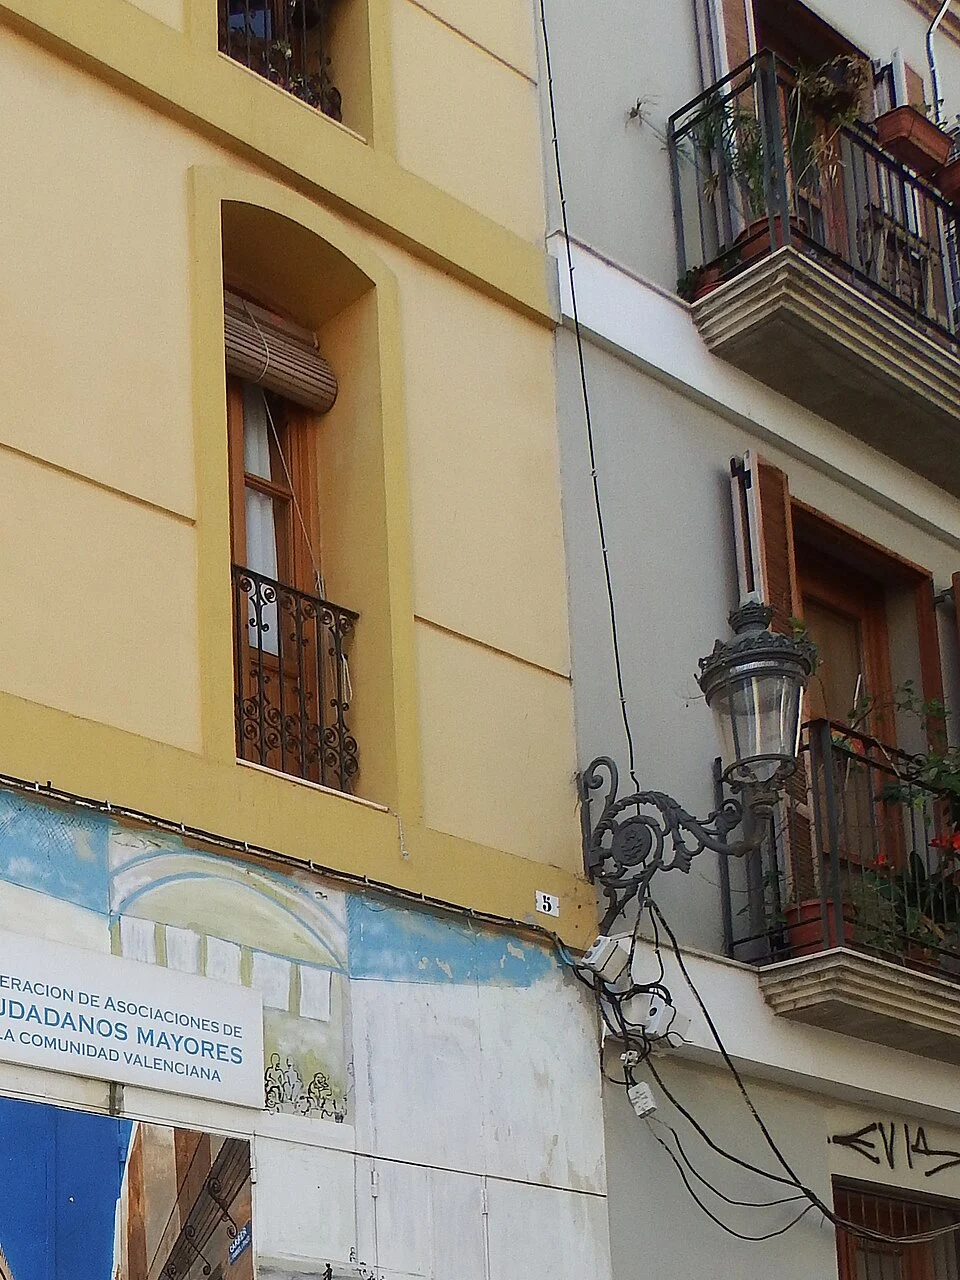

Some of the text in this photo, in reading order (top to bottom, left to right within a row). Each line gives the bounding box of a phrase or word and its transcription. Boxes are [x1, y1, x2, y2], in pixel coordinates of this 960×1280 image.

[542, 894, 552, 912] 5
[78, 991, 100, 1008] DE
[104, 996, 220, 1033] ASOCIACIONES
[223, 1023, 243, 1039] DE
[19, 1031, 120, 1062] COMUNIDAD
[123, 1051, 222, 1083] VALENCIANA
[136, 1026, 244, 1065] MAYORES
